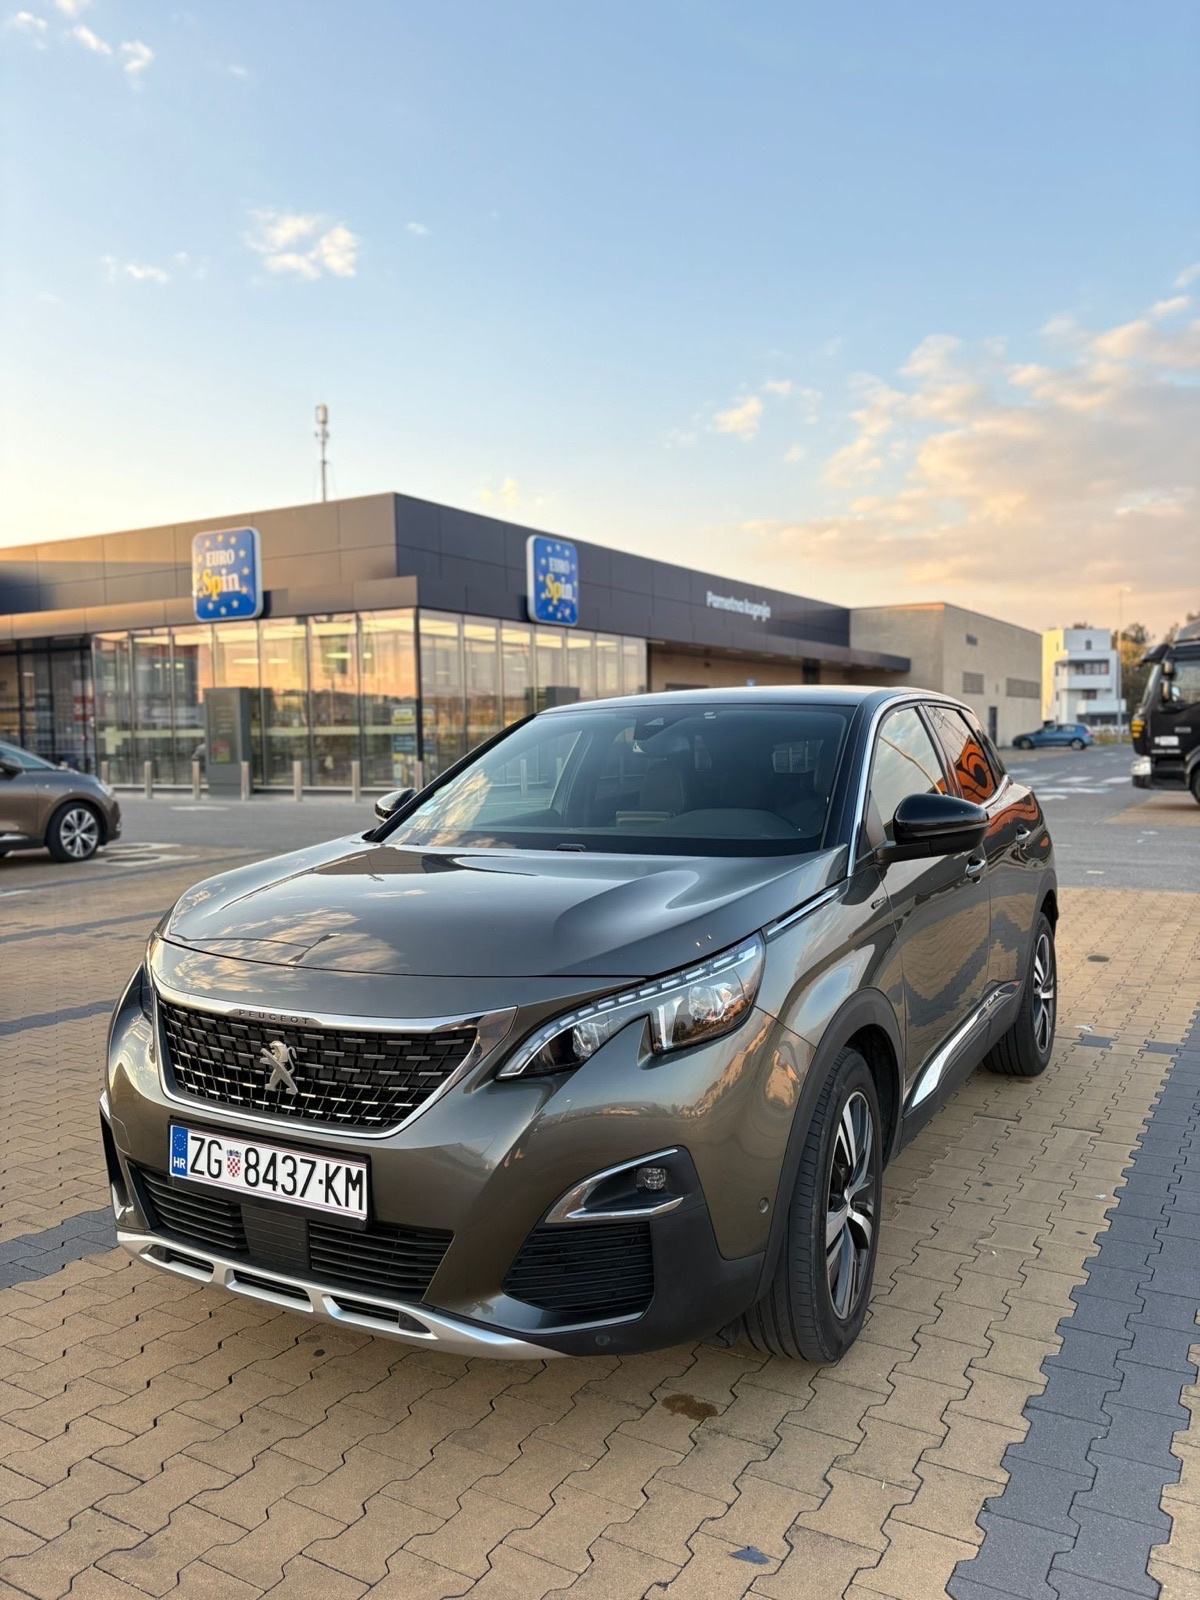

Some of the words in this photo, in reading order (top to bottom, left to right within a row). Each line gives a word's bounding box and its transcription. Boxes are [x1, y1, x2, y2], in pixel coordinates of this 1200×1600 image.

[206, 549, 235, 567] EURO
[548, 557, 571, 575] EURO
[202, 568, 240, 601] Spin
[545, 573, 573, 605] Spin
[238, 1009, 310, 1025] PEUGEOT
[173, 1157, 186, 1170] HR
[190, 1135, 222, 1179] ZG
